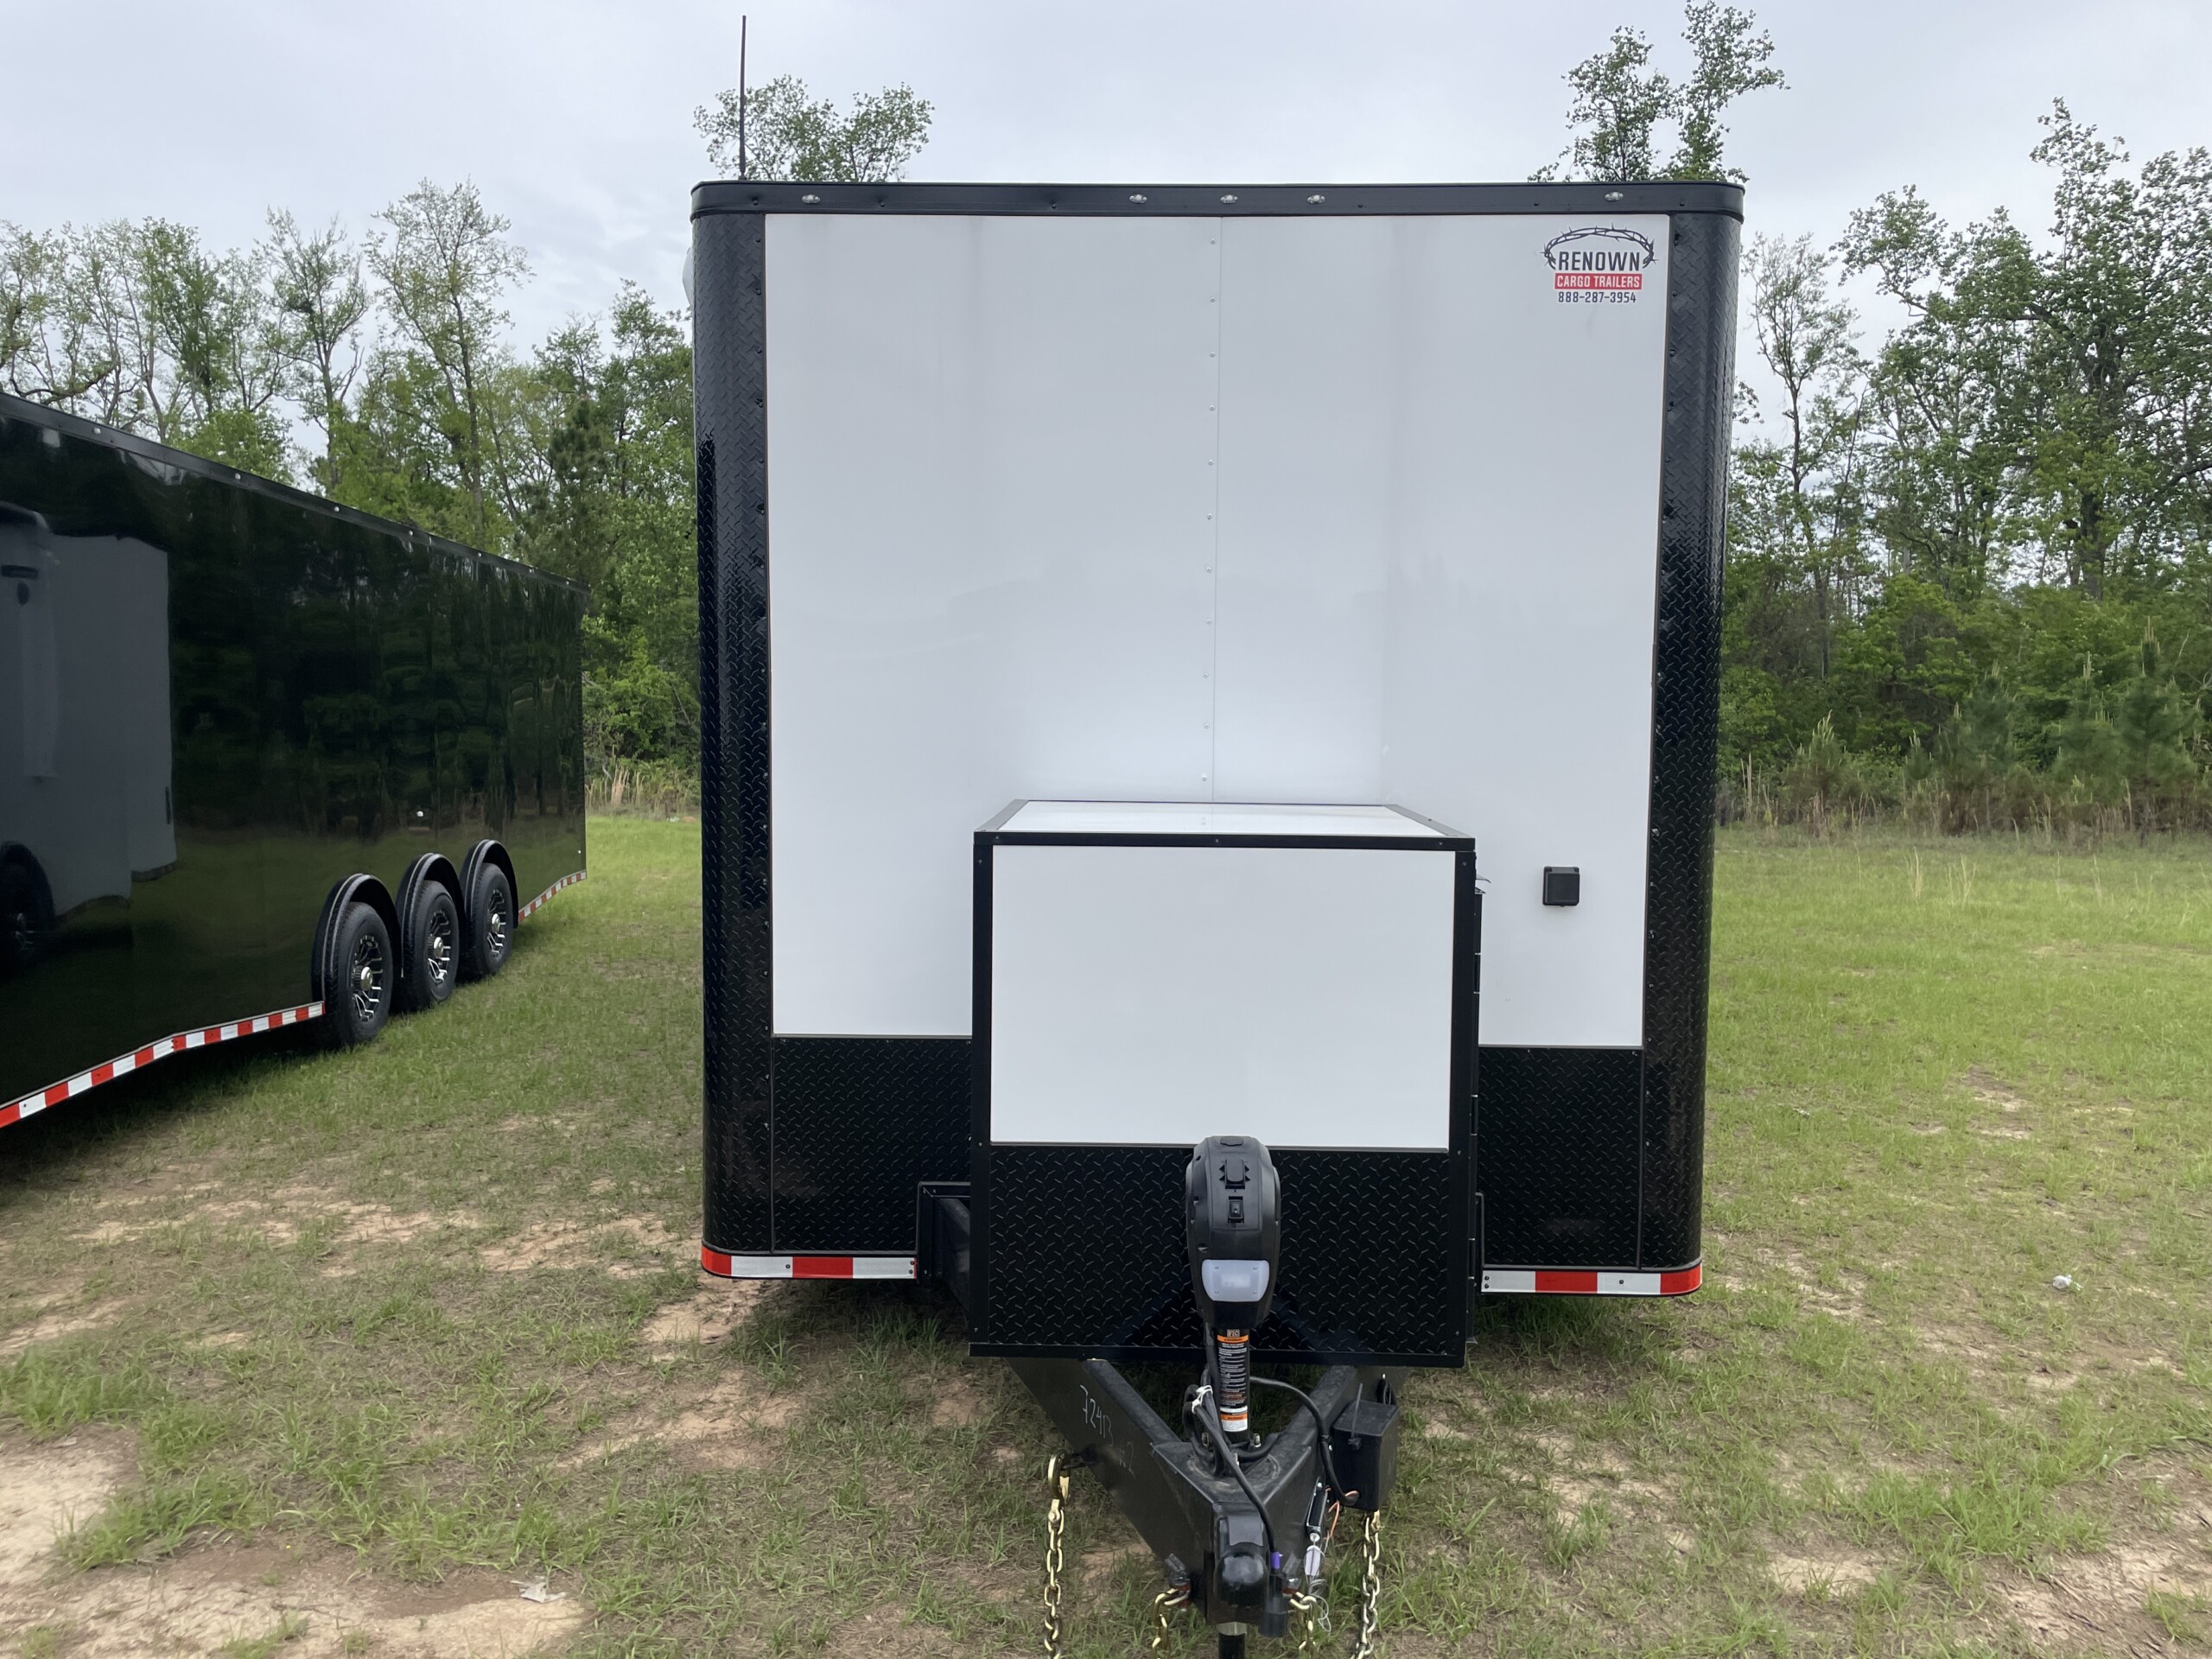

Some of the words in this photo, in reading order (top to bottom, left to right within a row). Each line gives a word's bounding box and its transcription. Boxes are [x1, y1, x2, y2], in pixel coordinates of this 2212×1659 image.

[1558, 251, 1640, 271] RENOWN
[1557, 275, 1591, 288] CARGO
[1593, 275, 1640, 288] TRAILERS
[1558, 291, 1637, 303] 888-287-3954
